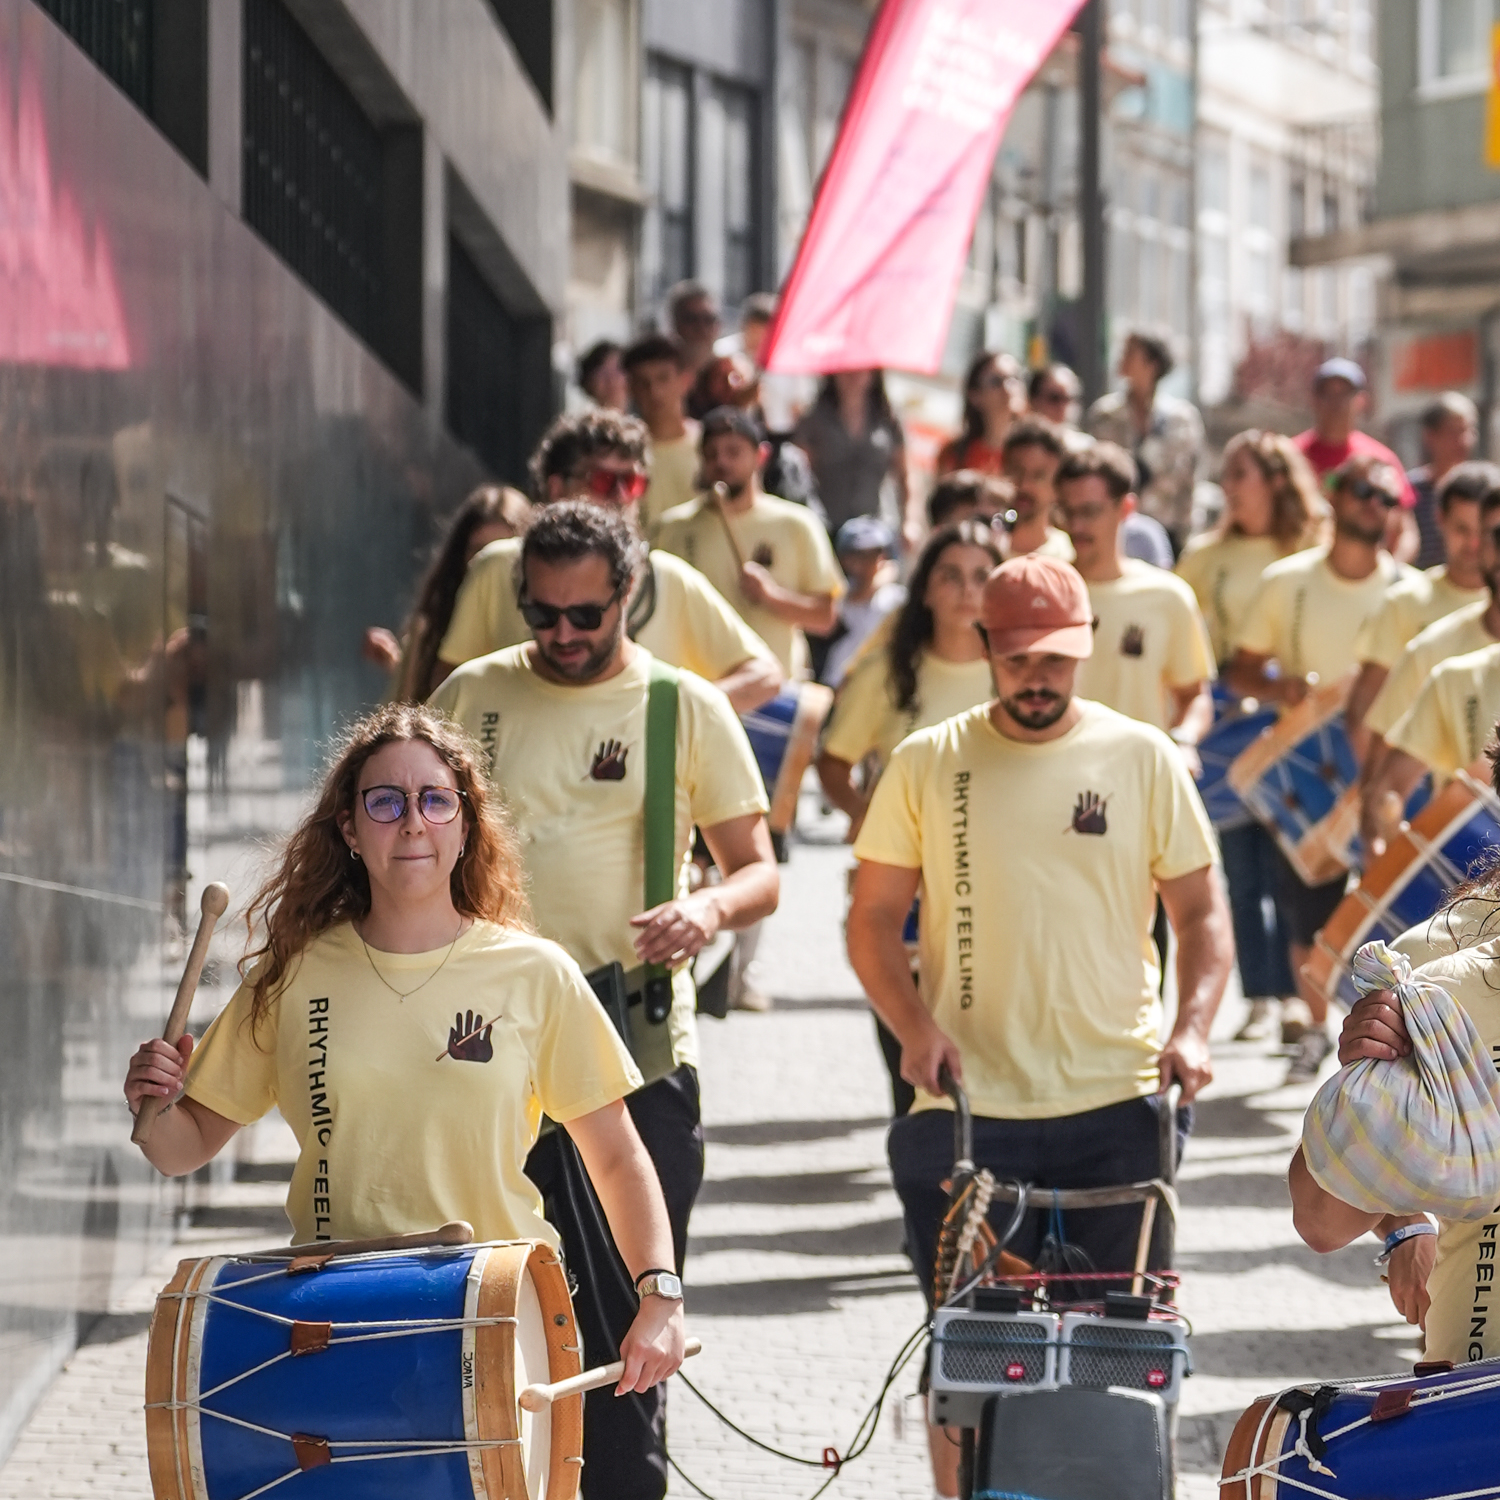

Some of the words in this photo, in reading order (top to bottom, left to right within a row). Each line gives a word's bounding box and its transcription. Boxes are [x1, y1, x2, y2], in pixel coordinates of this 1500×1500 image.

[953, 769, 972, 897] RHYTHMIC
[955, 905, 975, 1010] FEELING
[308, 997, 334, 1147] RHYTHMIC
[1468, 1223, 1499, 1363] FEELING
